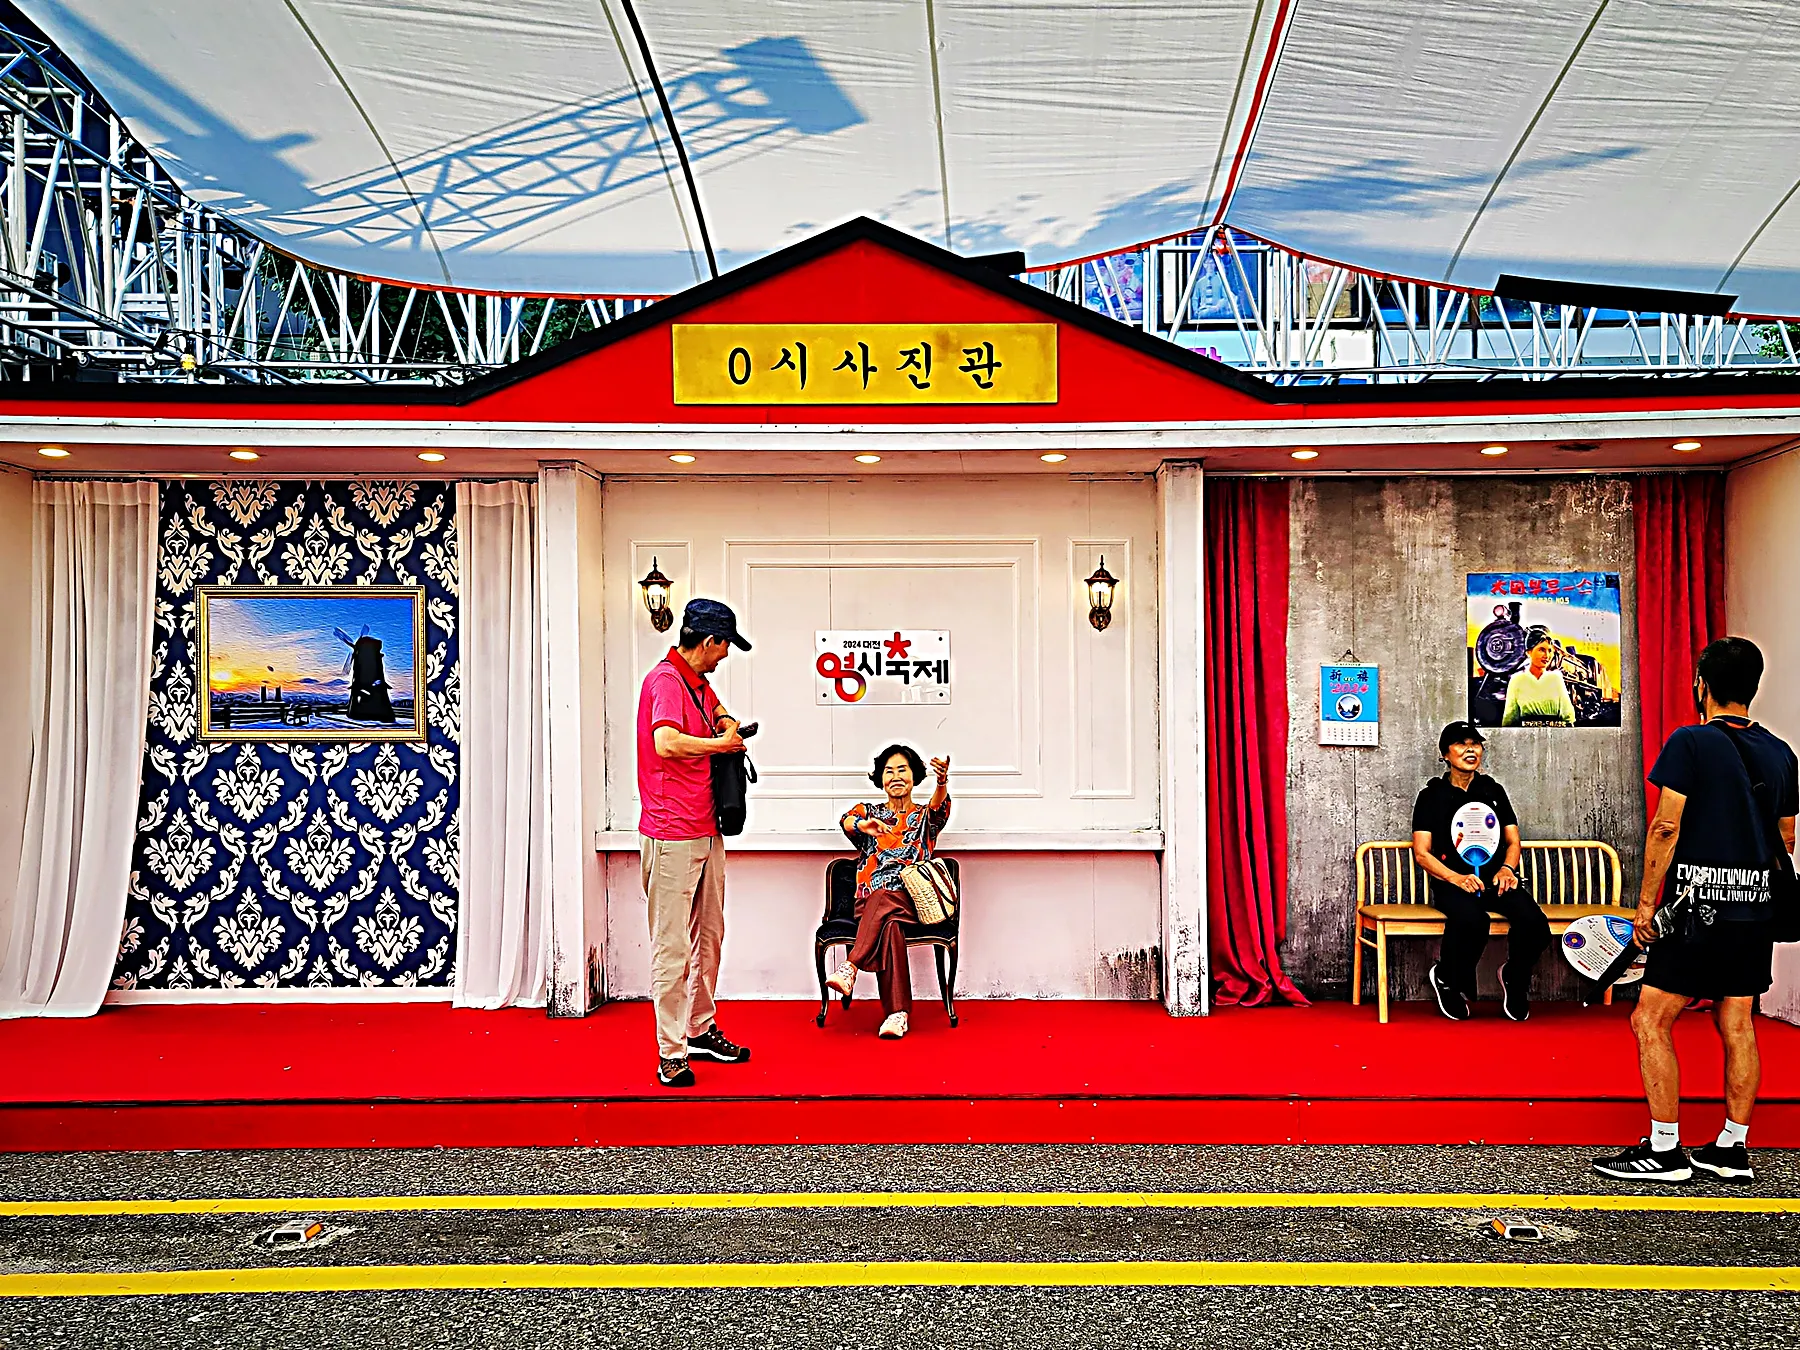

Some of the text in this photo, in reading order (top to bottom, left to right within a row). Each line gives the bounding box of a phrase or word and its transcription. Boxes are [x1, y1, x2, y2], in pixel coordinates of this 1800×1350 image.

[843, 640, 881, 650] 2024 대전
[816, 631, 949, 703] 영시축제
